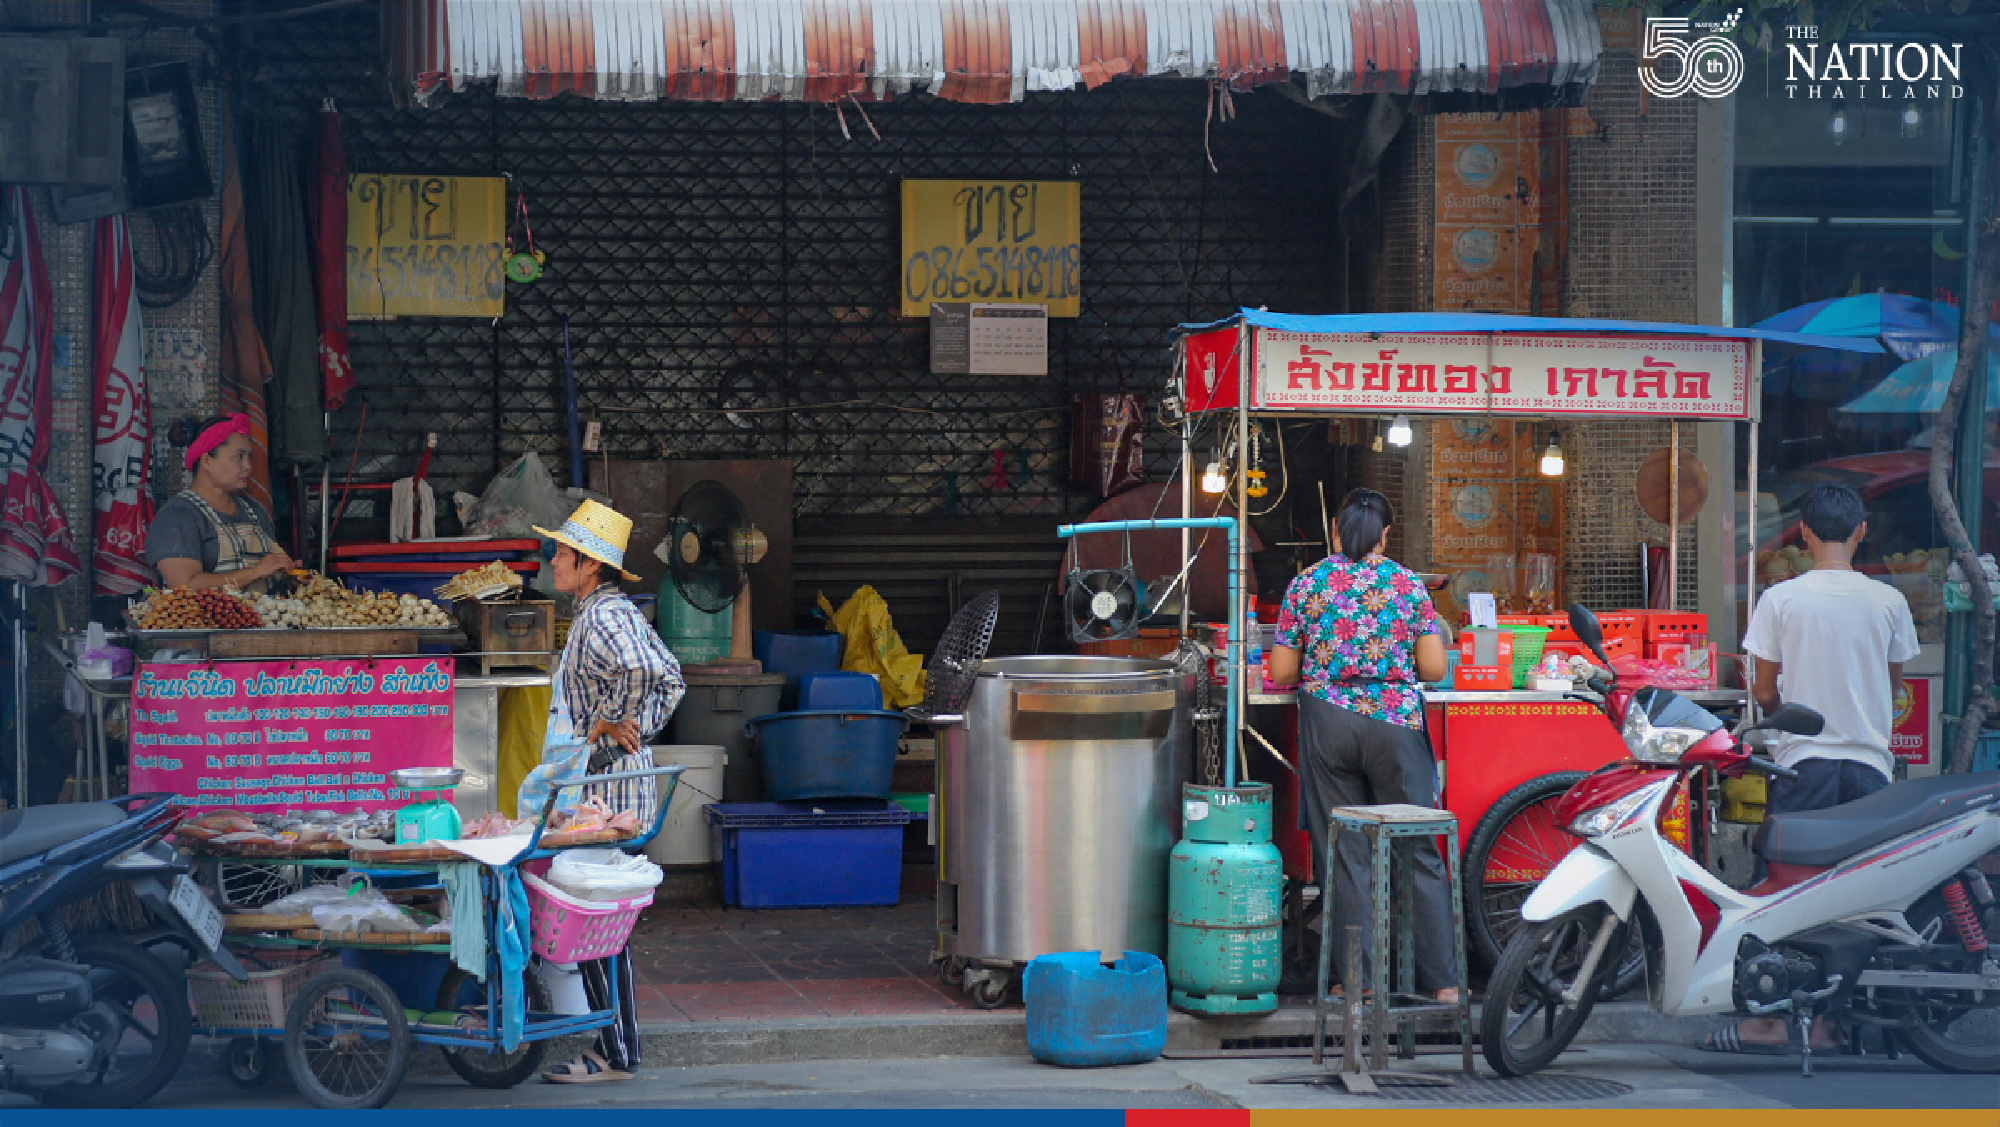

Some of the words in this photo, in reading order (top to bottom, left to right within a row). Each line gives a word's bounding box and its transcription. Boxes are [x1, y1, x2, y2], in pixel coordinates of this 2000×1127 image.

[358, 177, 458, 240] ขาย
[952, 183, 1038, 245] ขาย
[347, 242, 502, 301] 6-5148118
[906, 243, 1080, 302] 086-5148118
[1287, 344, 1513, 395] สังข์ทอง
[1546, 355, 1713, 399] เกาลัด
[243, 665, 374, 697] ปลาหมึกย่าง
